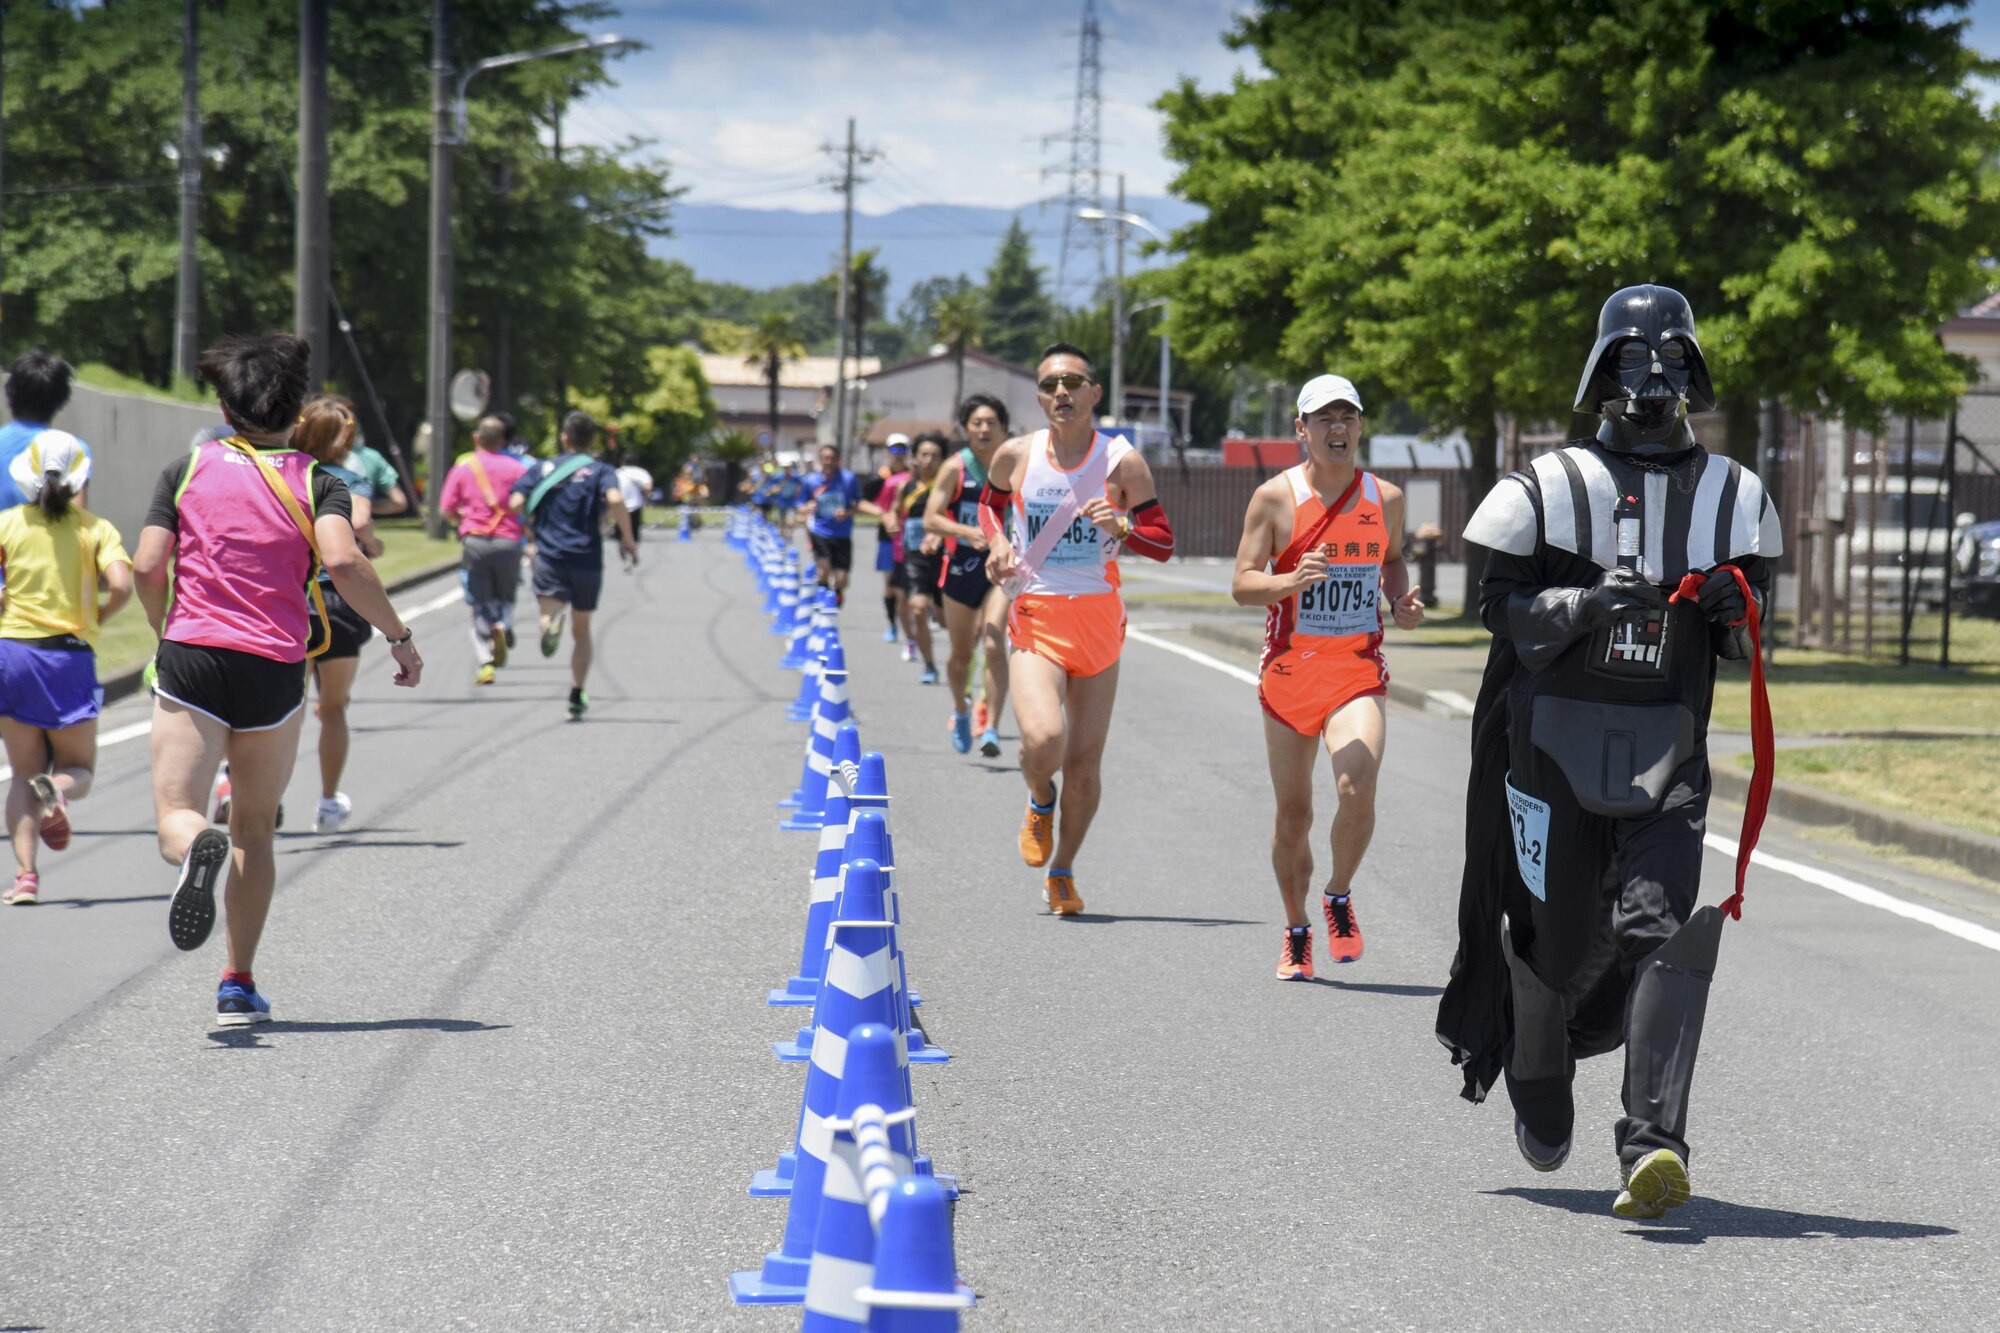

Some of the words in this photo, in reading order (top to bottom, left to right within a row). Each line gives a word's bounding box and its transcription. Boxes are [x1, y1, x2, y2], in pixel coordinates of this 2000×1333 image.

[1311, 543, 1380, 557] 田病院
[1350, 565, 1377, 573] STRIDERS
[1301, 580, 1375, 612] B1079-2
[1300, 613, 1336, 622] EKIDEN
[1512, 793, 1544, 813] STRIDERS
